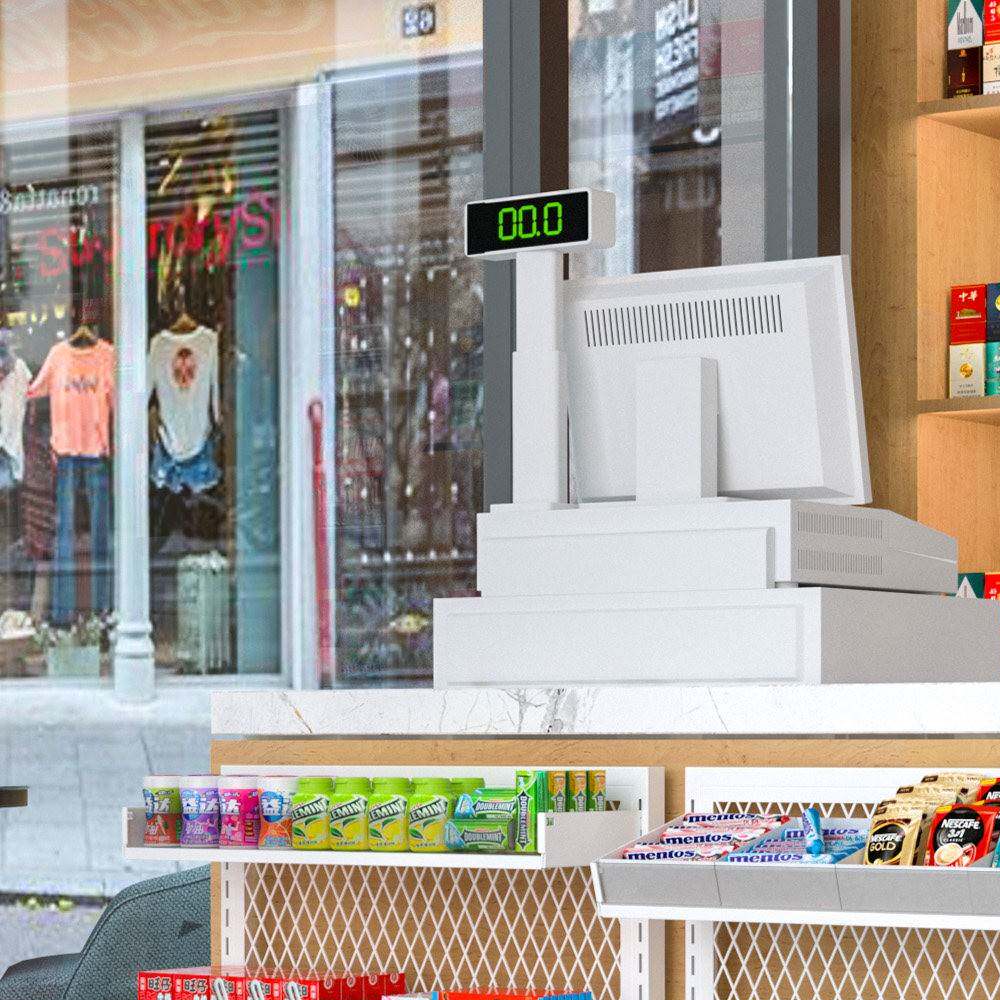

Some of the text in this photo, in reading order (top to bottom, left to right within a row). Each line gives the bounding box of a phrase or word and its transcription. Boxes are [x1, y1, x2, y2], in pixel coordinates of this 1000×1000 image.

[499, 202, 562, 240] 00.0
[688, 812, 756, 823] mentos
[665, 833, 732, 844] mentos
[870, 841, 897, 852] GOLD
[628, 849, 695, 861] mentos
[729, 853, 803, 864] mentos
